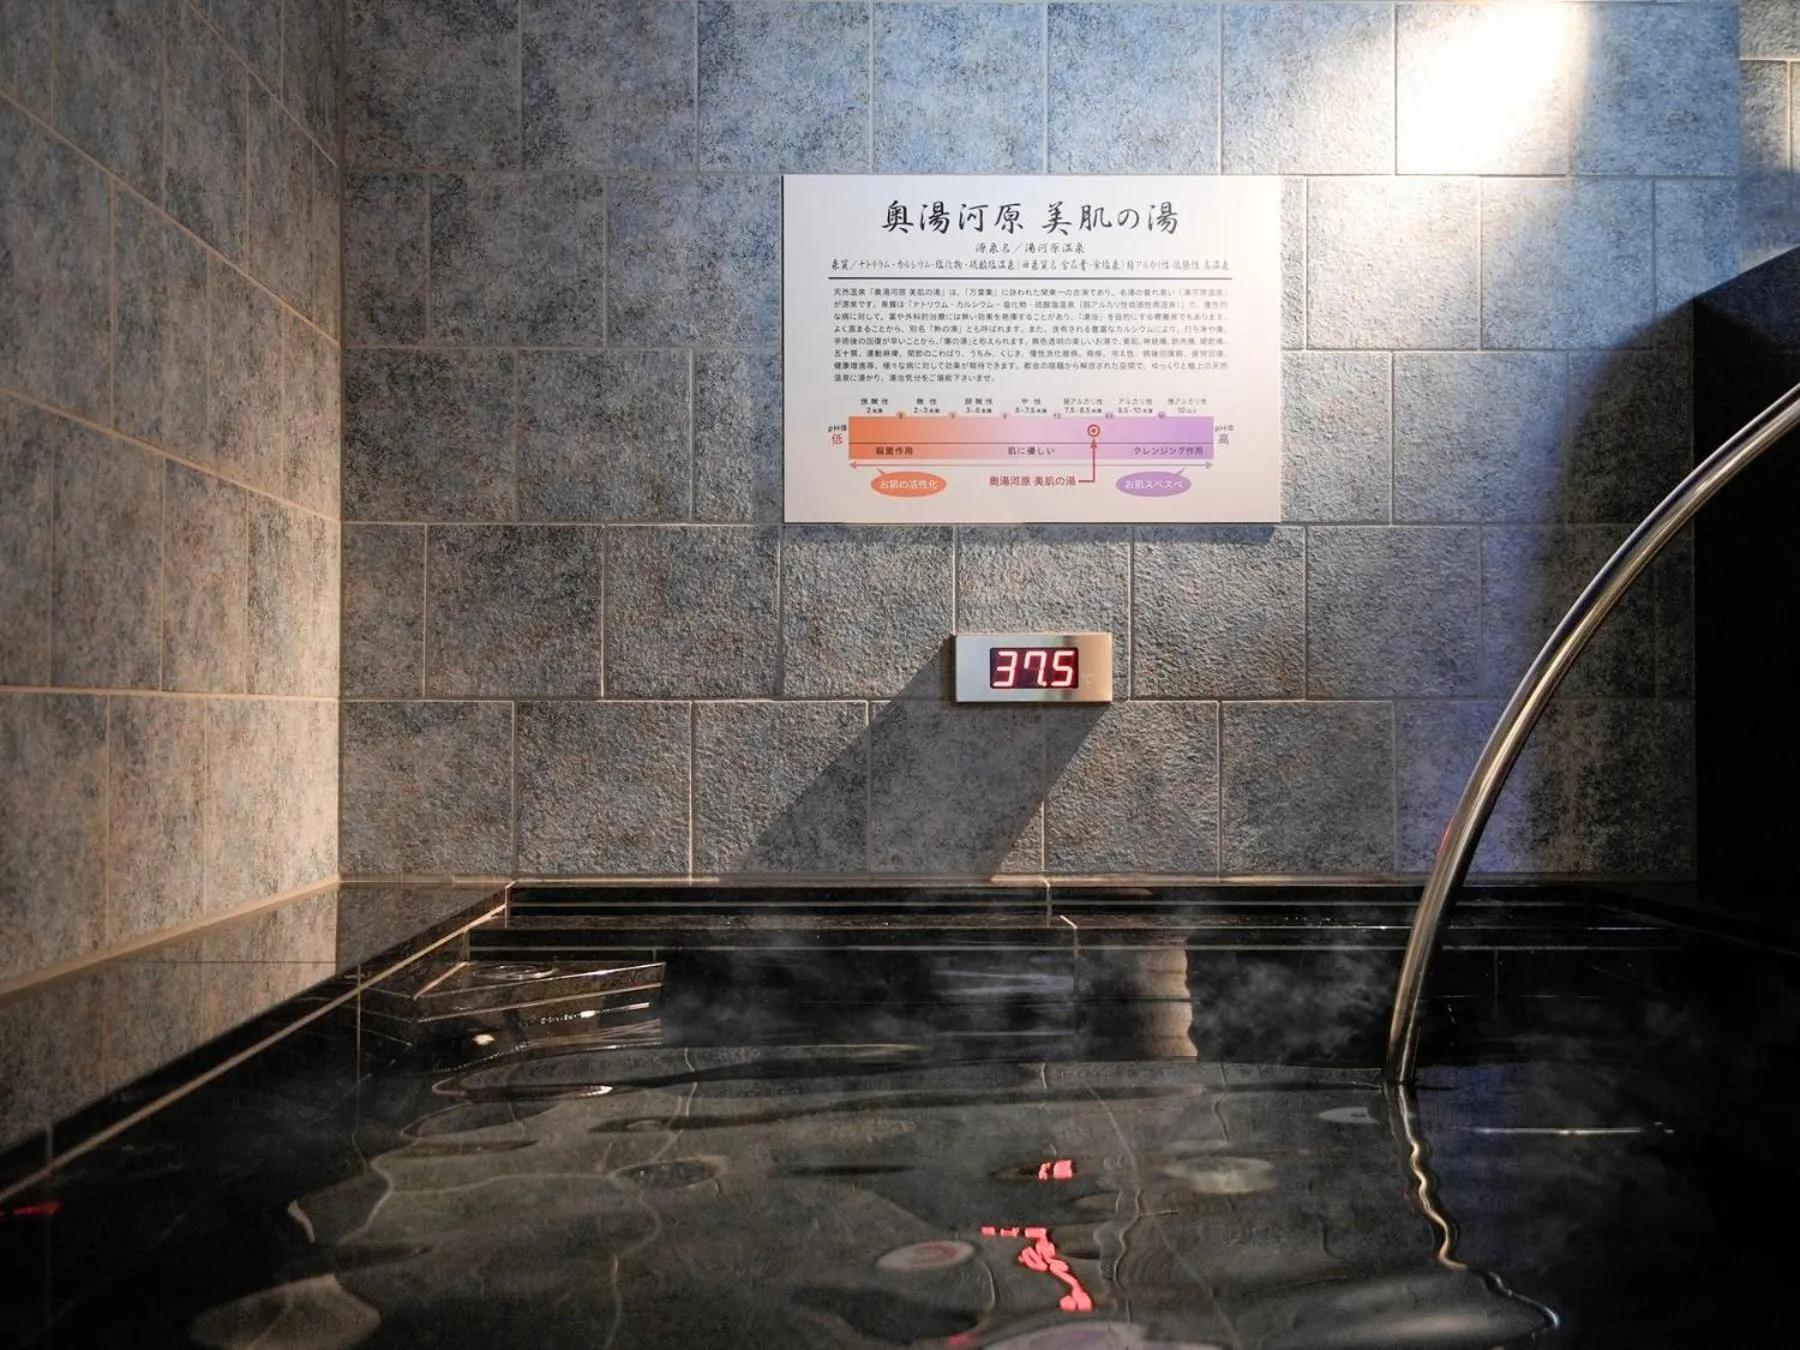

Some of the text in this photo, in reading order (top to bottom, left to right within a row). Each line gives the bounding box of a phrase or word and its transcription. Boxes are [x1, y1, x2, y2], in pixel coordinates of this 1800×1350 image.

[880, 199, 1179, 235] 奥湯河原 美肌の湯
[831, 433, 843, 446] 低
